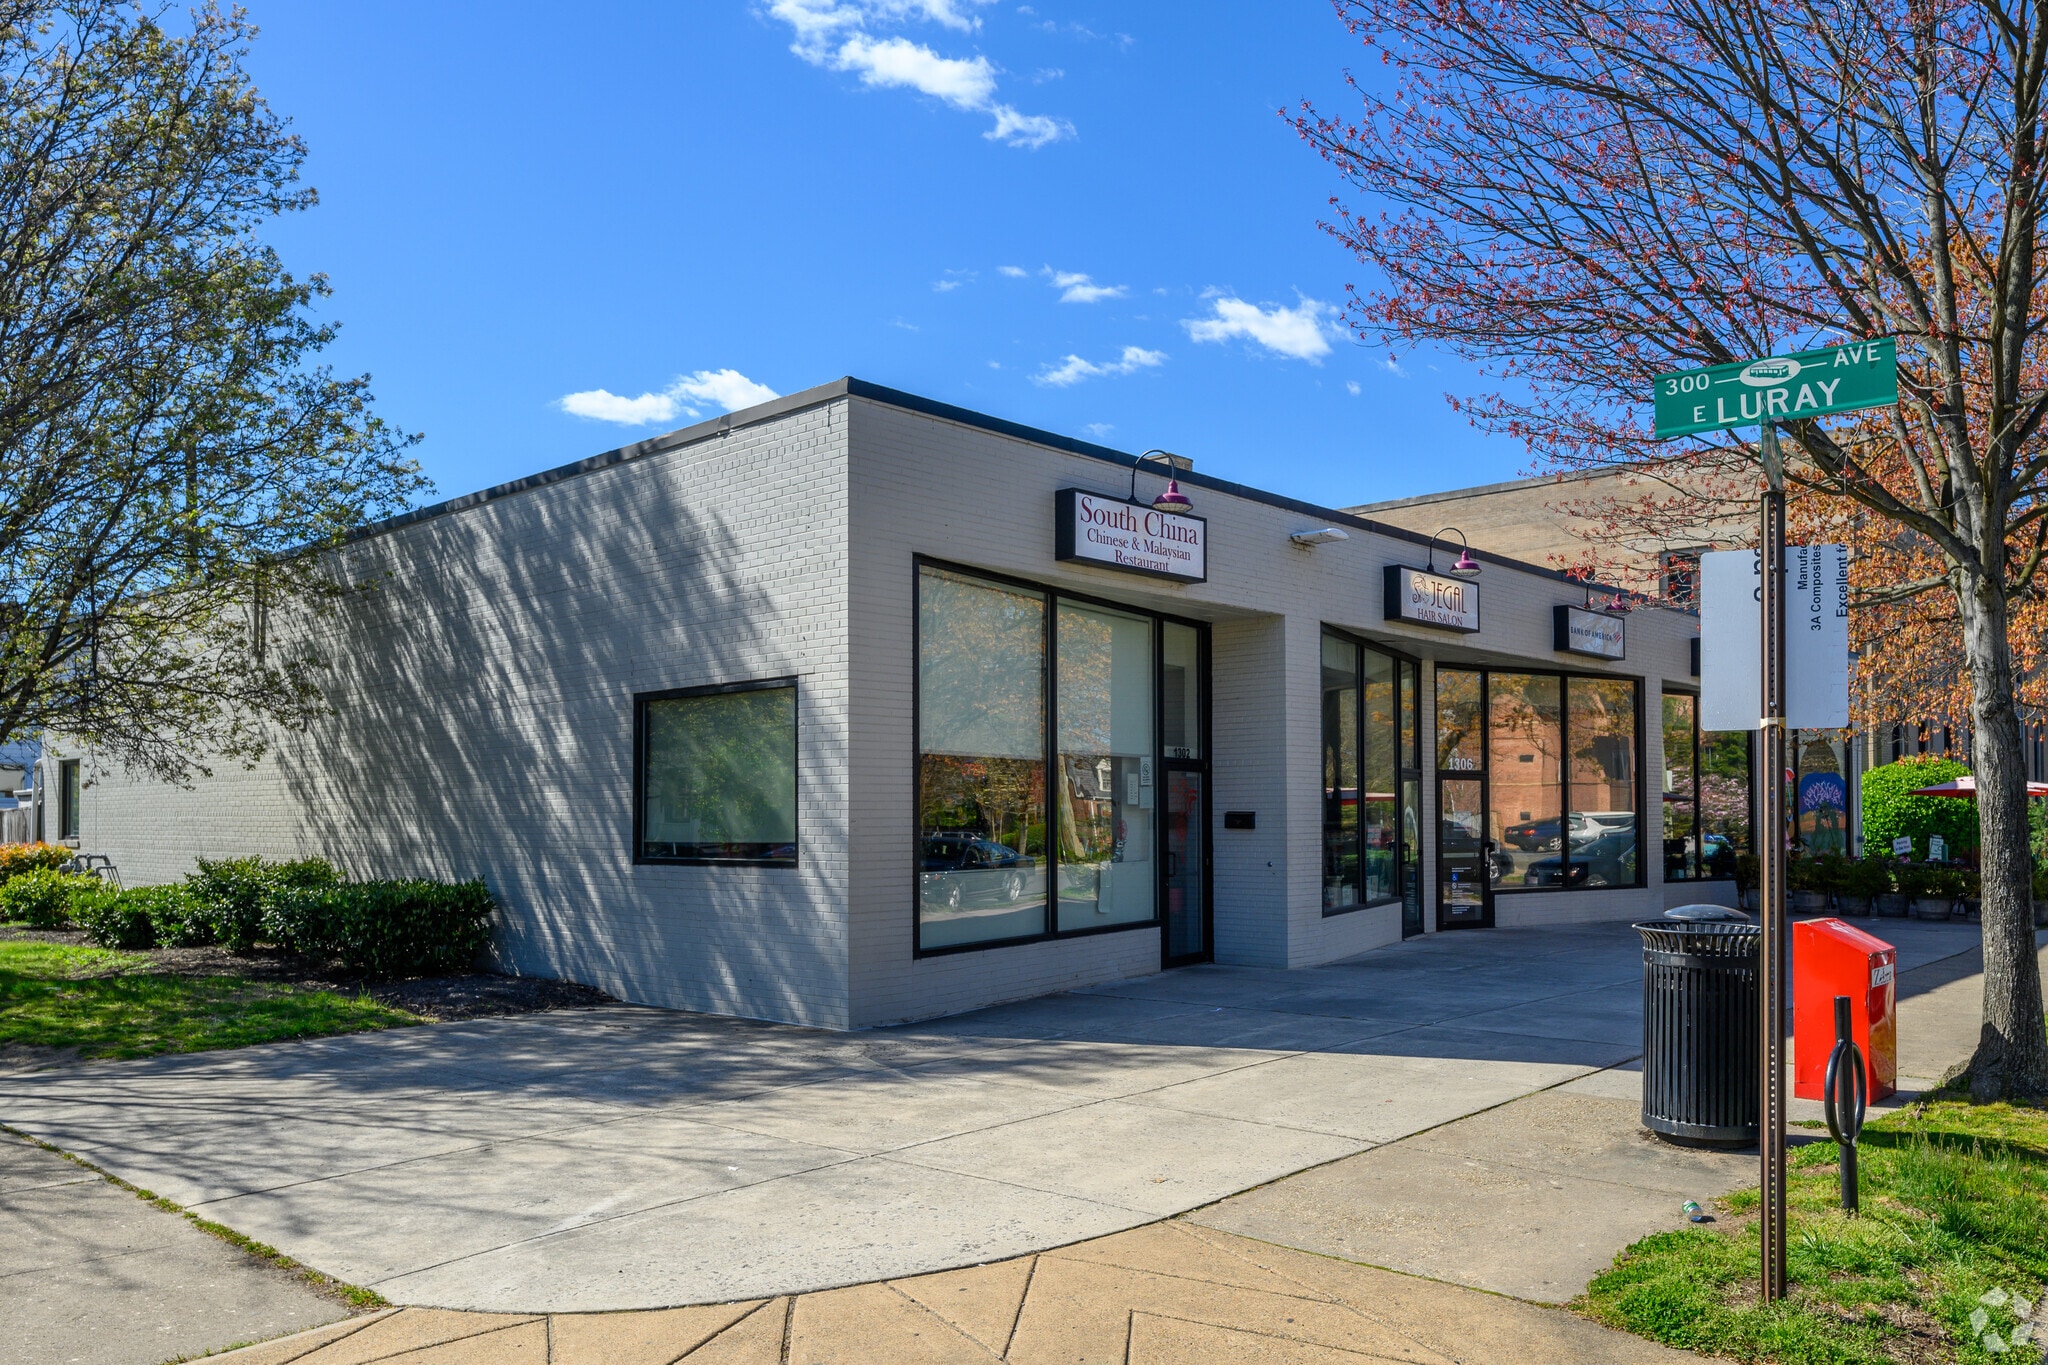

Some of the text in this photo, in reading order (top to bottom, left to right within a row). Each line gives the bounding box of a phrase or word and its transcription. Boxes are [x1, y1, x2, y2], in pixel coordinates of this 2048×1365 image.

[1833, 342, 1881, 368] AVE
[1665, 373, 1710, 396] 300
[1693, 377, 1841, 423] E LURAY
[1080, 496, 1199, 546] South China
[1087, 528, 1191, 561] Chinese & Malaysian
[1114, 549, 1170, 572] Restaurant
[1430, 581, 1467, 614] JEGAL
[1810, 545, 1823, 631] 3A Composites
[1836, 556, 1848, 617] Excellent
[1417, 608, 1463, 626] HAIR SALON
[1570, 626, 1612, 642] BANK OF AMERICA
[1173, 748, 1191, 758] 1302
[1448, 757, 1473, 770] 1306
